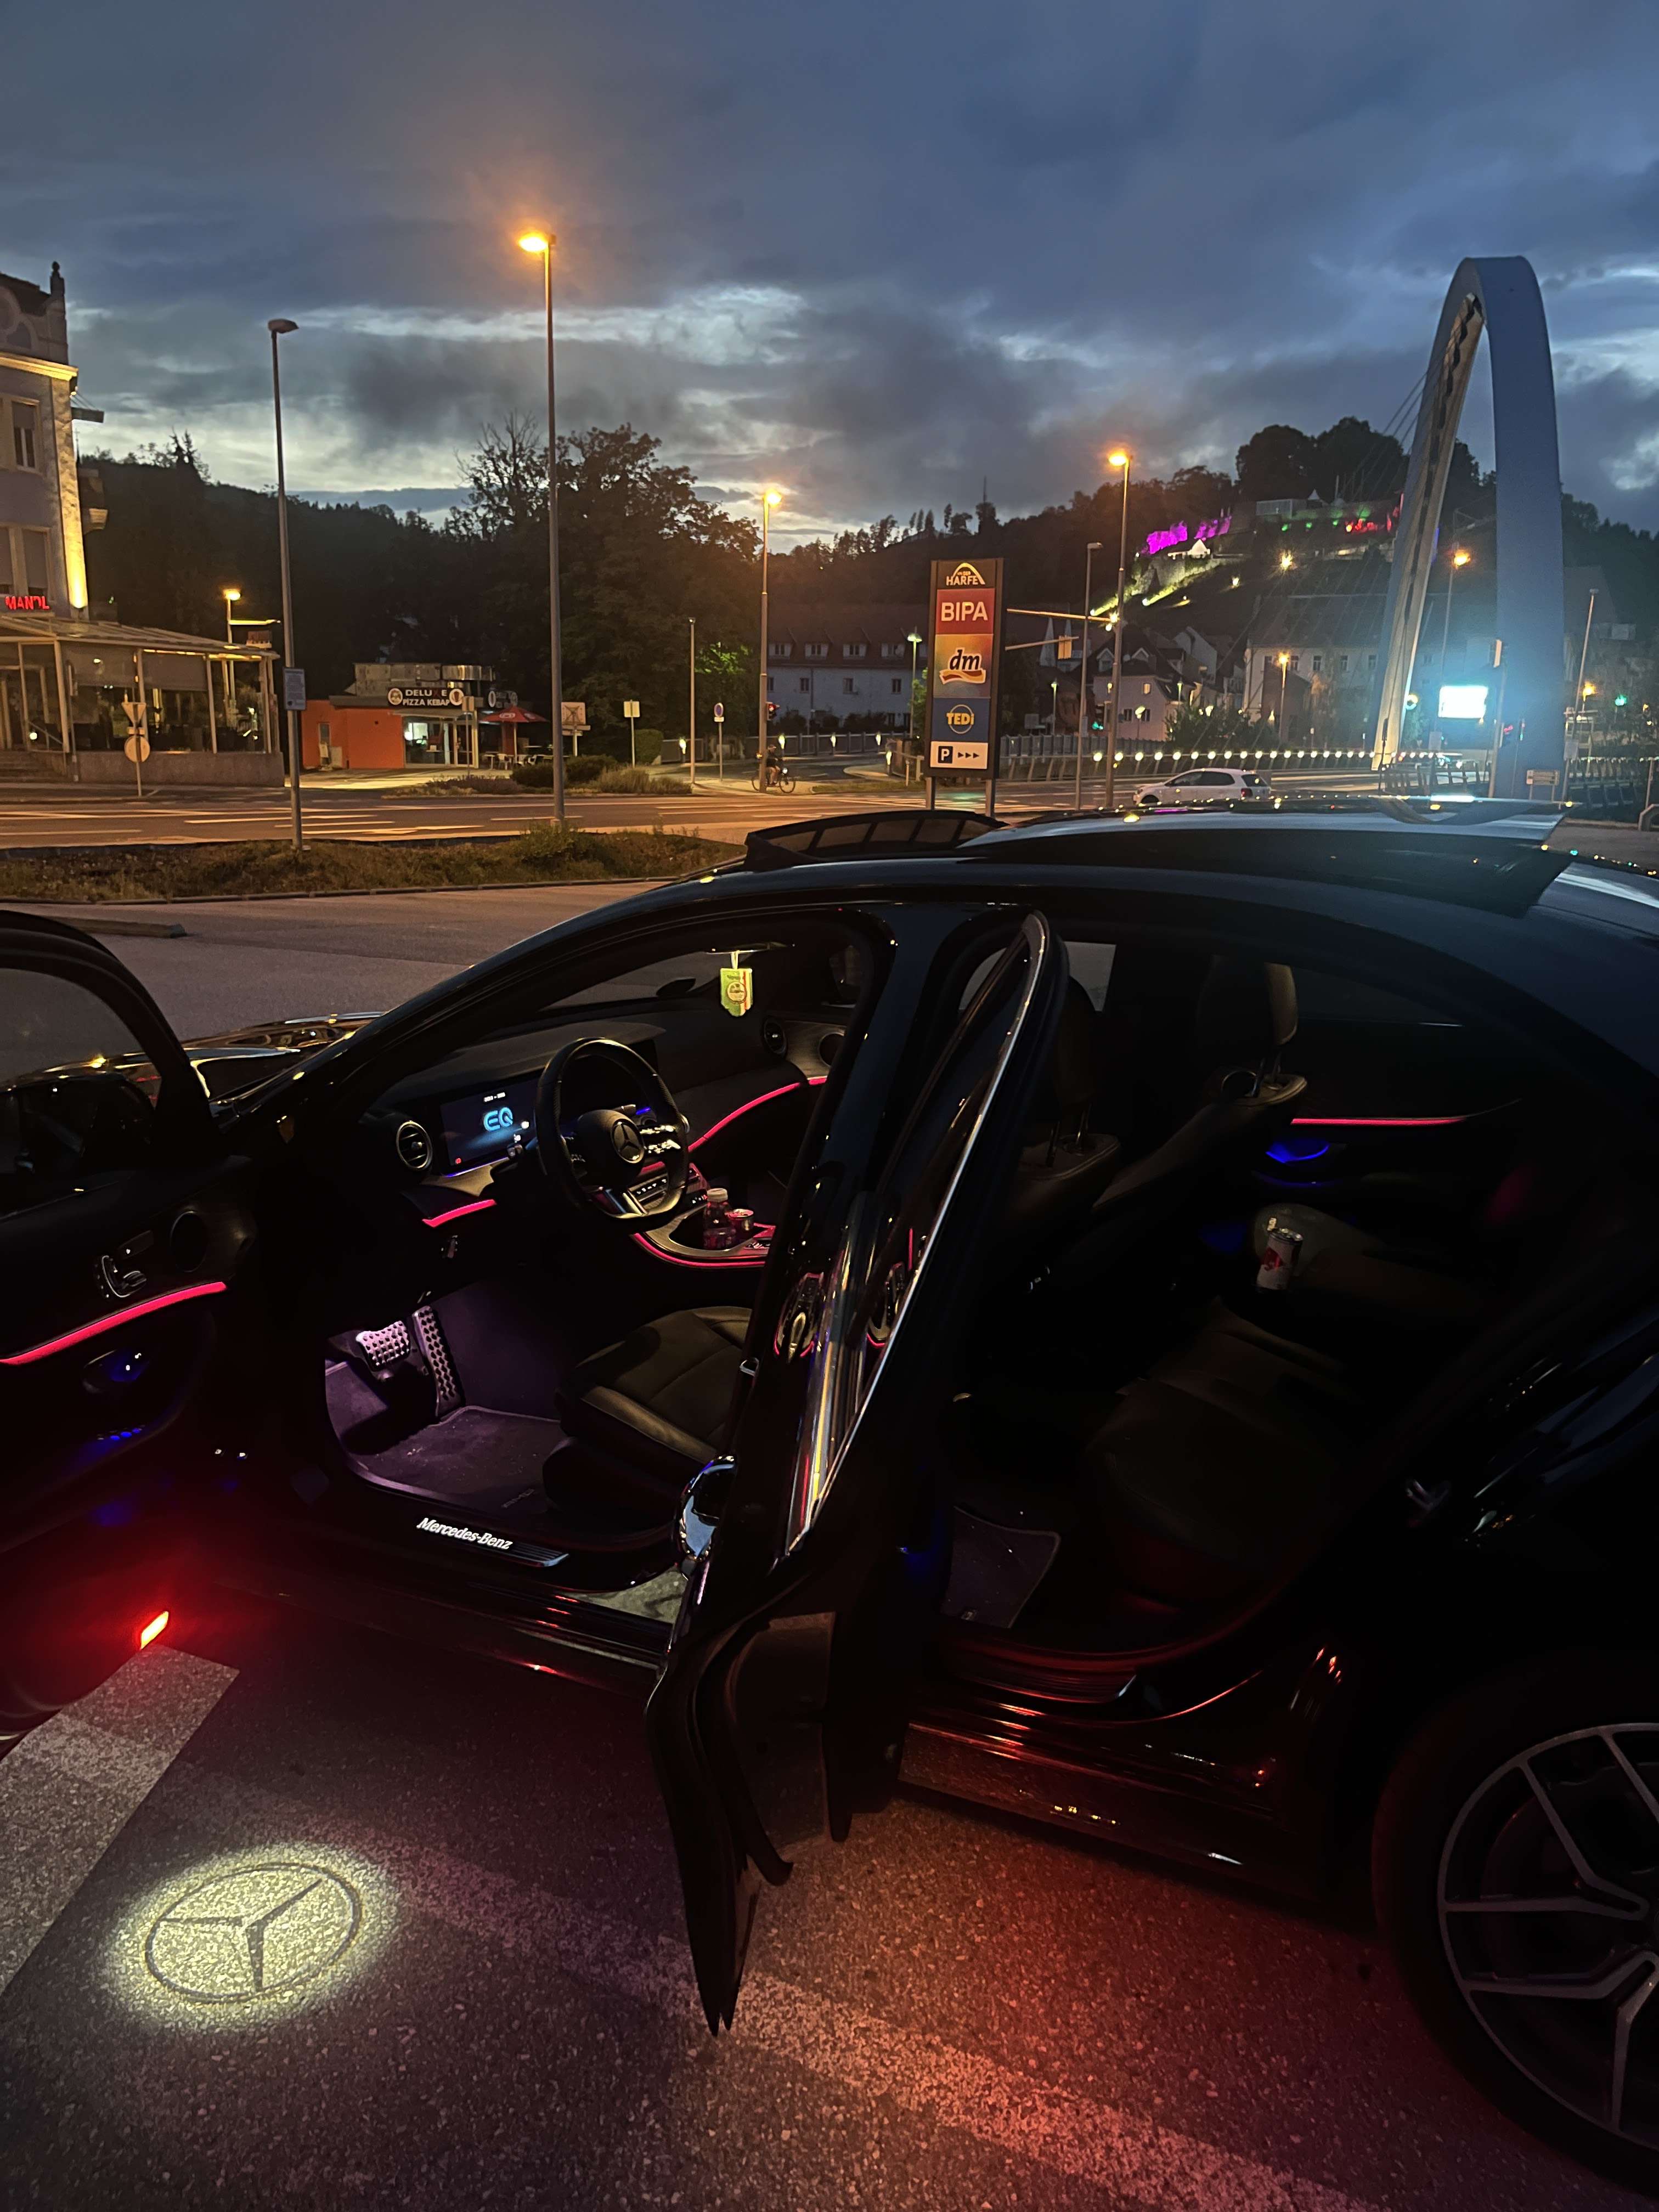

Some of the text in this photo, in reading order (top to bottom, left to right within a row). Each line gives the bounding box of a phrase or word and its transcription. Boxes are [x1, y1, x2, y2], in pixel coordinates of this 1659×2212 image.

[946, 575, 979, 585] HARFE
[941, 602, 988, 622] BIPA
[949, 650, 980, 670] dm
[941, 748, 950, 761] P
[483, 1107, 514, 1131] EQ
[416, 1517, 514, 1550] Mercedes-Benz
